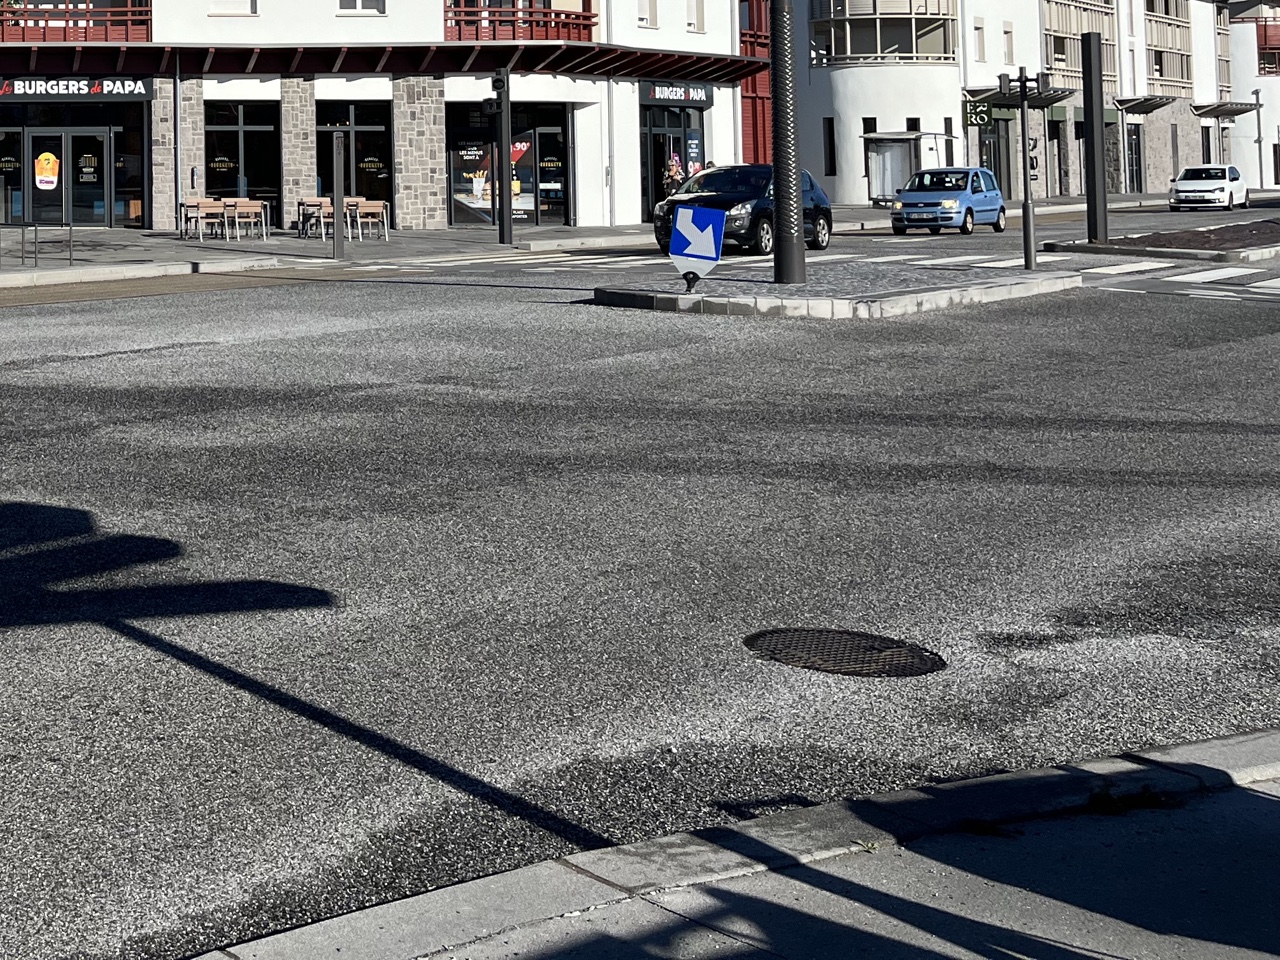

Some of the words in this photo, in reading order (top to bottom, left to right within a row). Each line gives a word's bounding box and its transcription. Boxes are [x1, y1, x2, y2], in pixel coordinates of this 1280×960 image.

[13, 80, 89, 94] BURGERS
[103, 80, 146, 94] PAPA
[655, 86, 685, 100] BURGERS
[689, 88, 707, 101] PAPA
